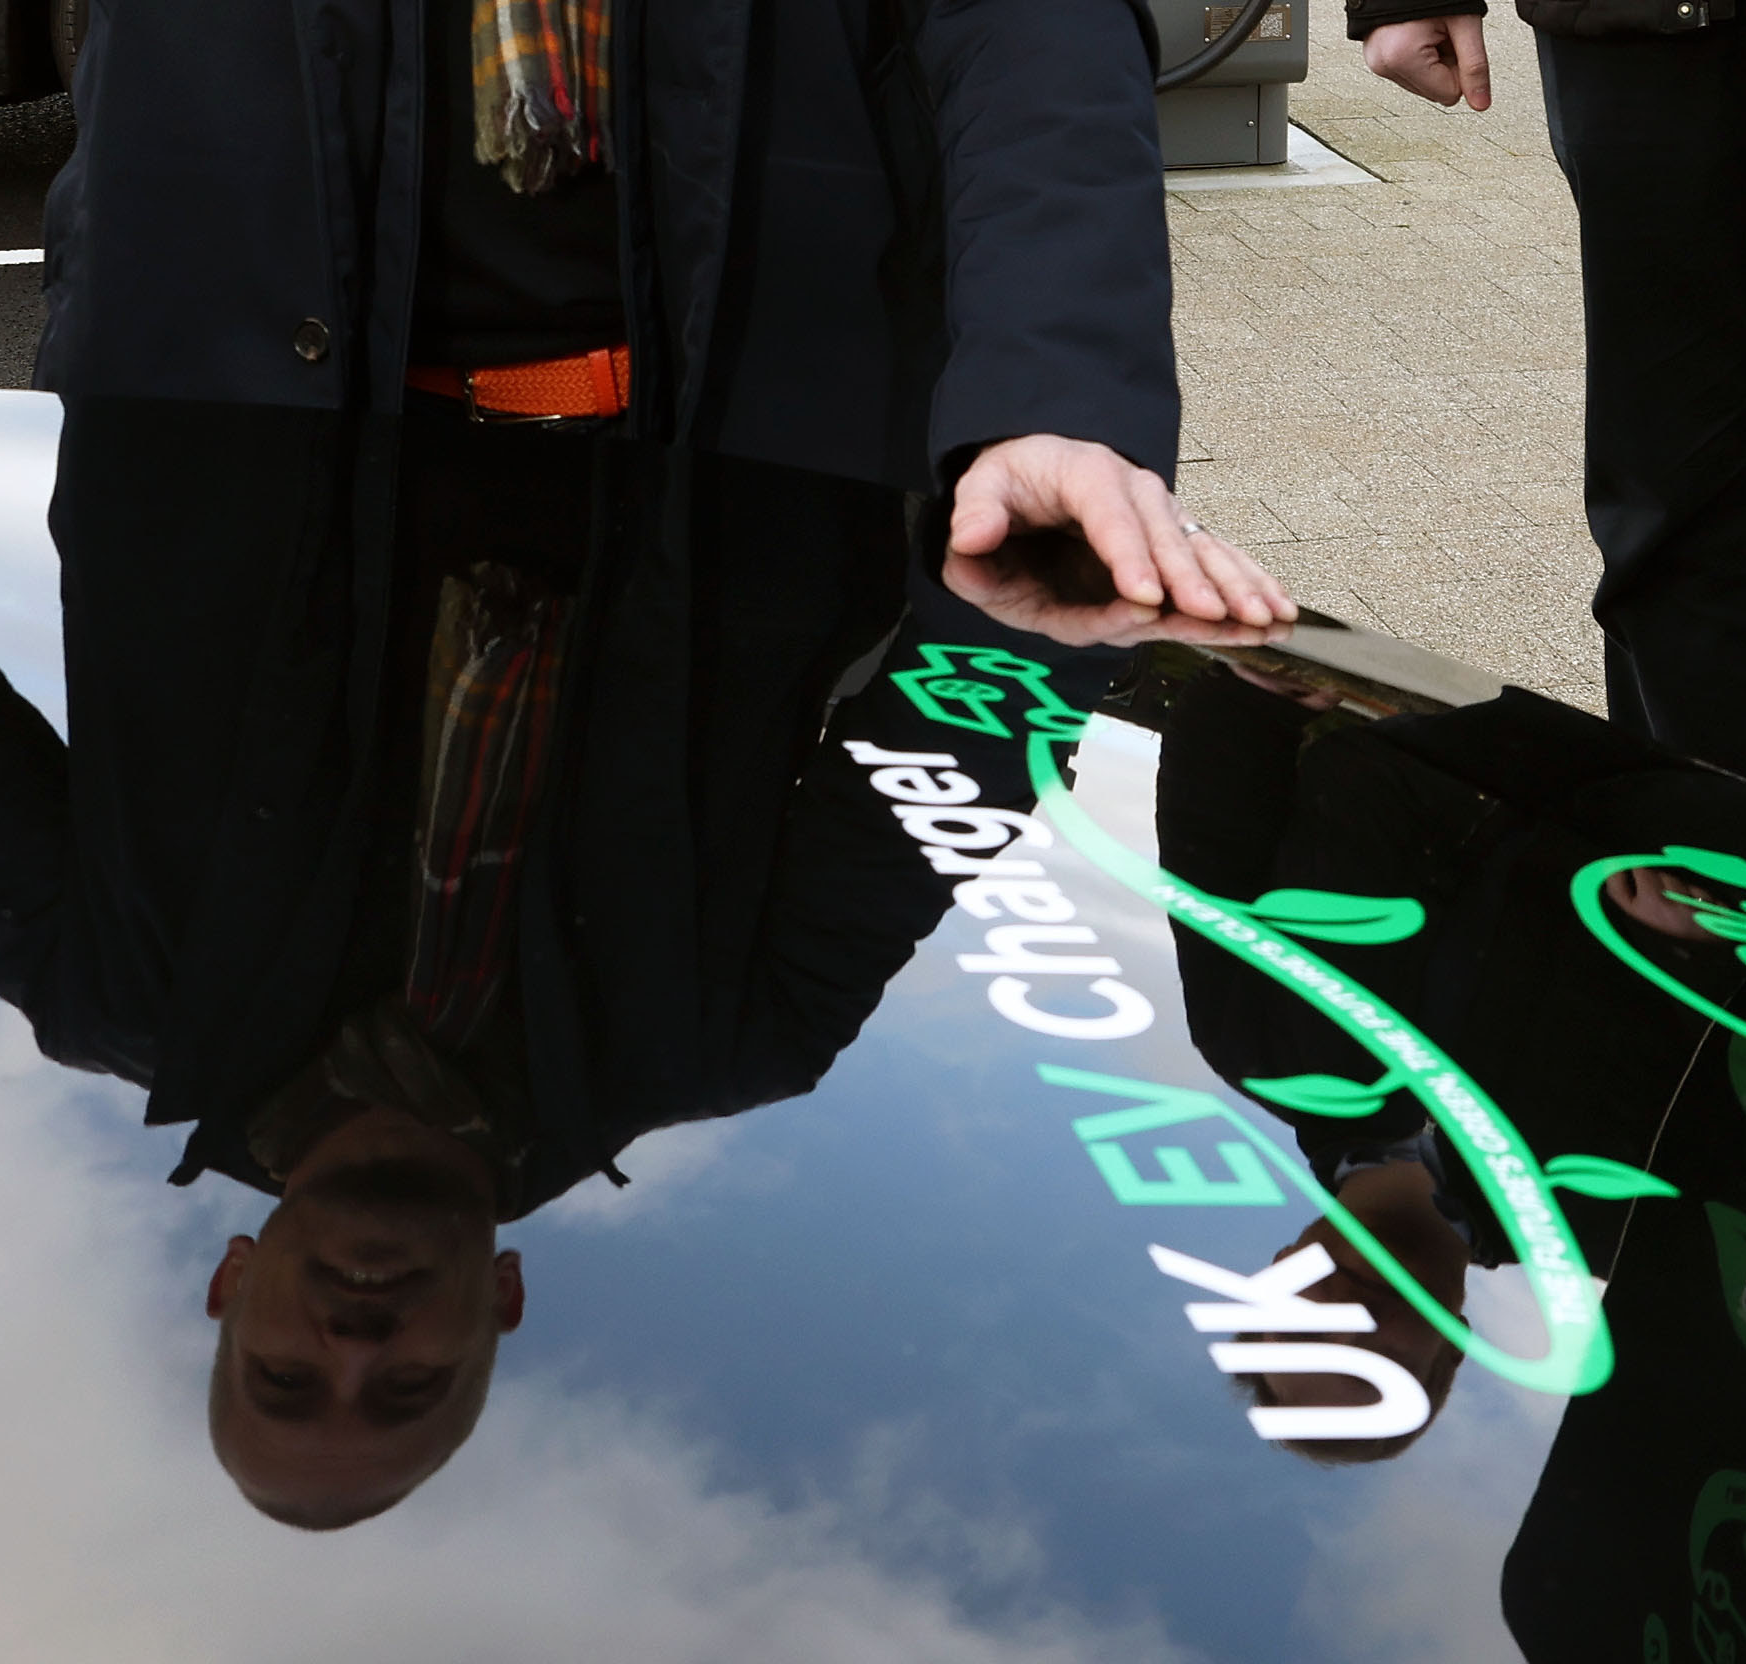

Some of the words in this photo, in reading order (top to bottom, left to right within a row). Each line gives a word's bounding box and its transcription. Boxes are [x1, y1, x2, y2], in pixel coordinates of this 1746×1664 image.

[842, 739, 1156, 1040] Charger
[1035, 1063, 1288, 1206] EV
[1148, 1241, 1432, 1441] UK
[1539, 1272, 1590, 1326] THE
